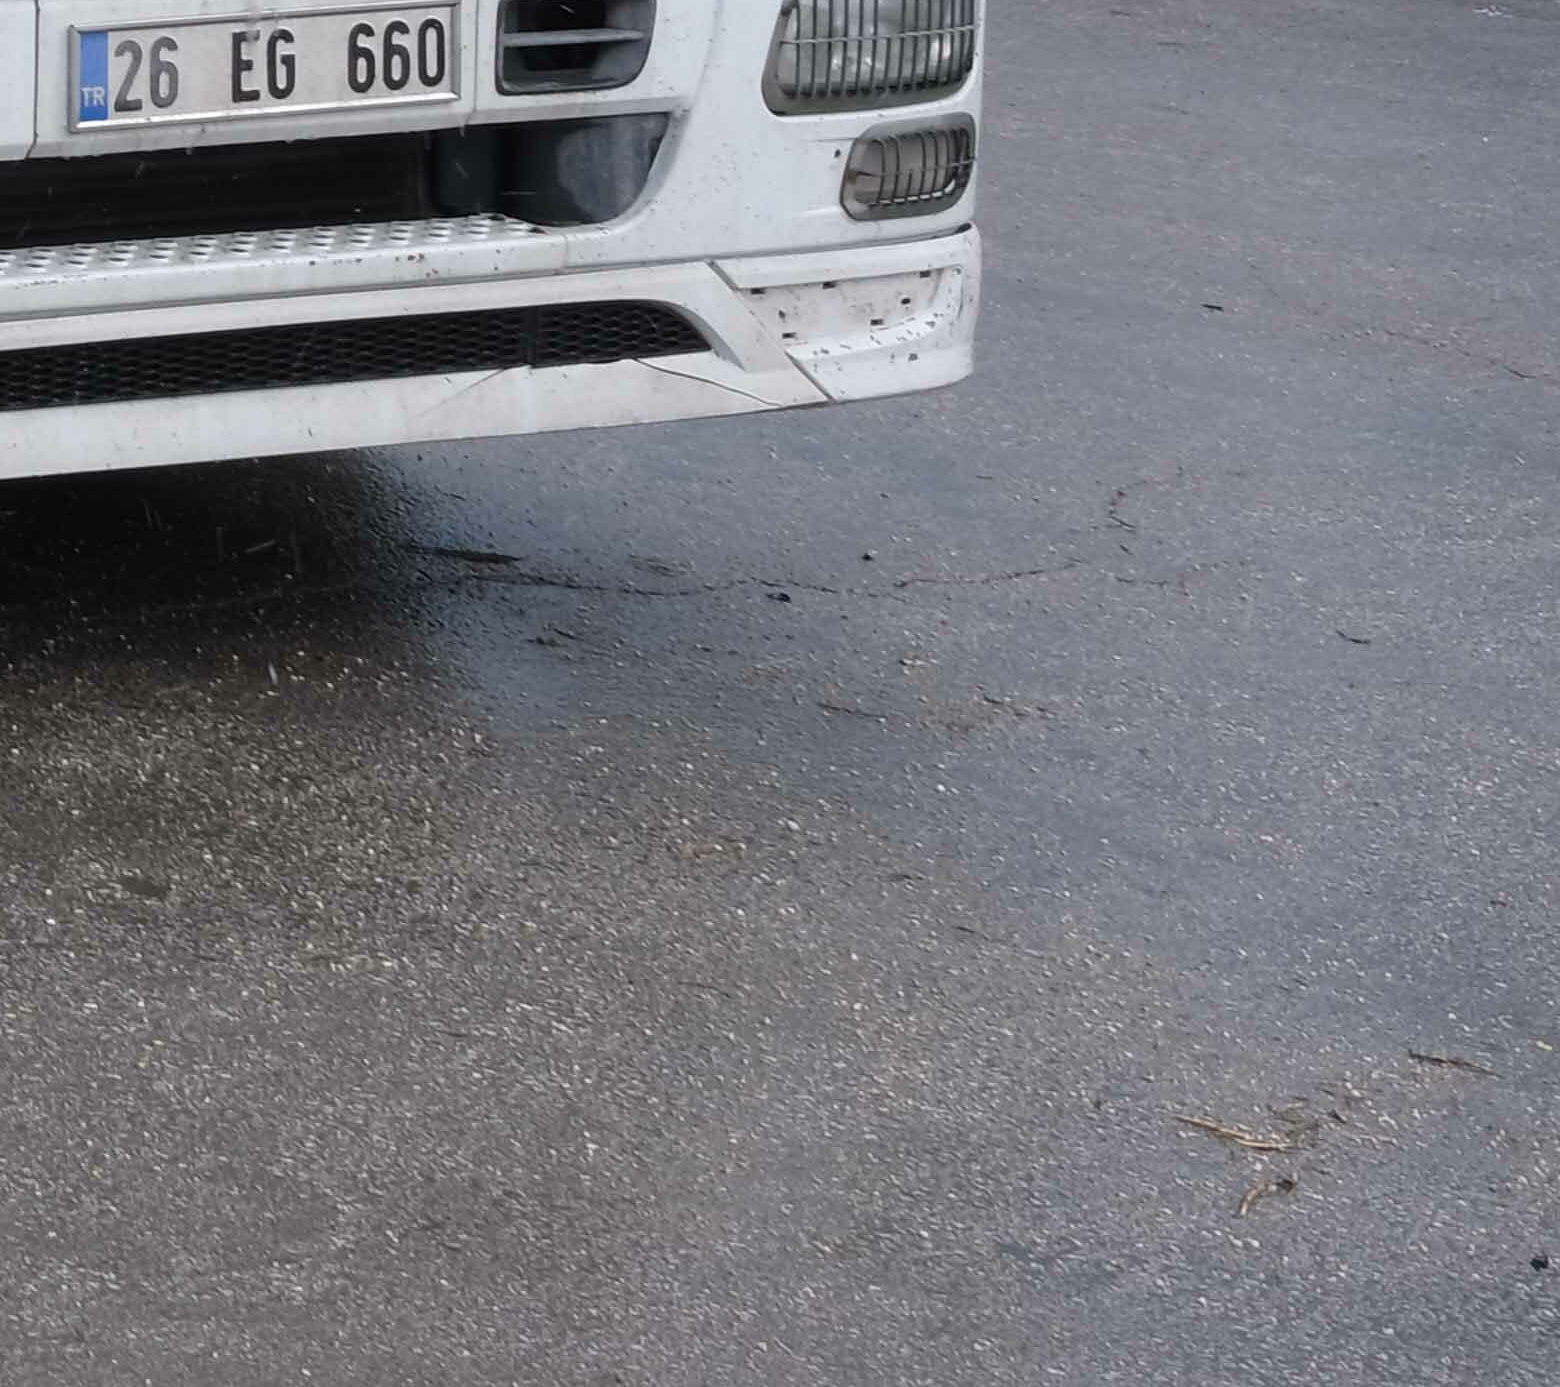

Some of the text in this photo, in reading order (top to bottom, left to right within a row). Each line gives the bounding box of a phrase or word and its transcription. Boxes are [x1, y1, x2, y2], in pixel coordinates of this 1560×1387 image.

[114, 18, 445, 112] 26 EG 660
[80, 86, 105, 108] TR
